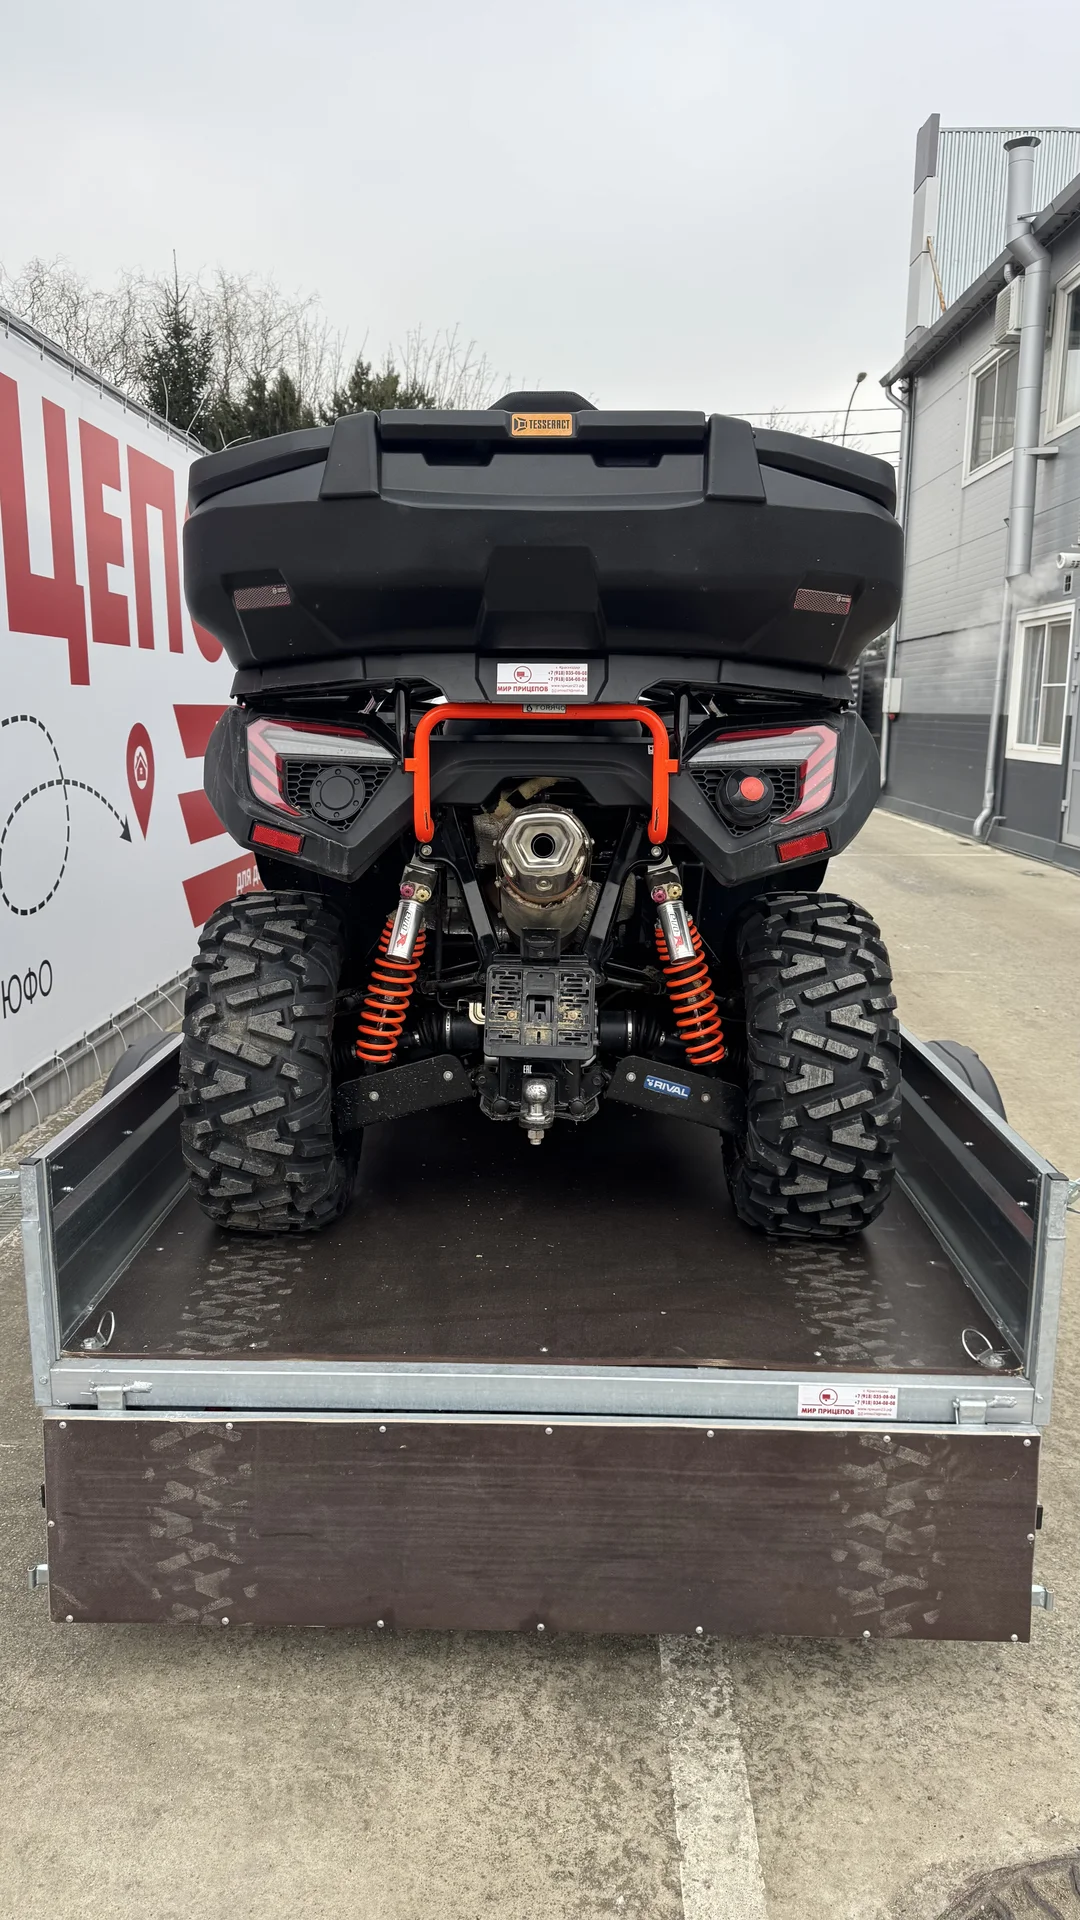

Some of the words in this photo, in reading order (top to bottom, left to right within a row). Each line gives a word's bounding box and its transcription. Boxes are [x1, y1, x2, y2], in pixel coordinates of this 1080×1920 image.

[529, 420, 570, 429] TESSERACT
[0, 372, 223, 685] ЦЕП
[236, 867, 251, 895] ДЛЯ
[1, 959, 53, 1019] ЮФО
[653, 1080, 689, 1097] RIVAL
